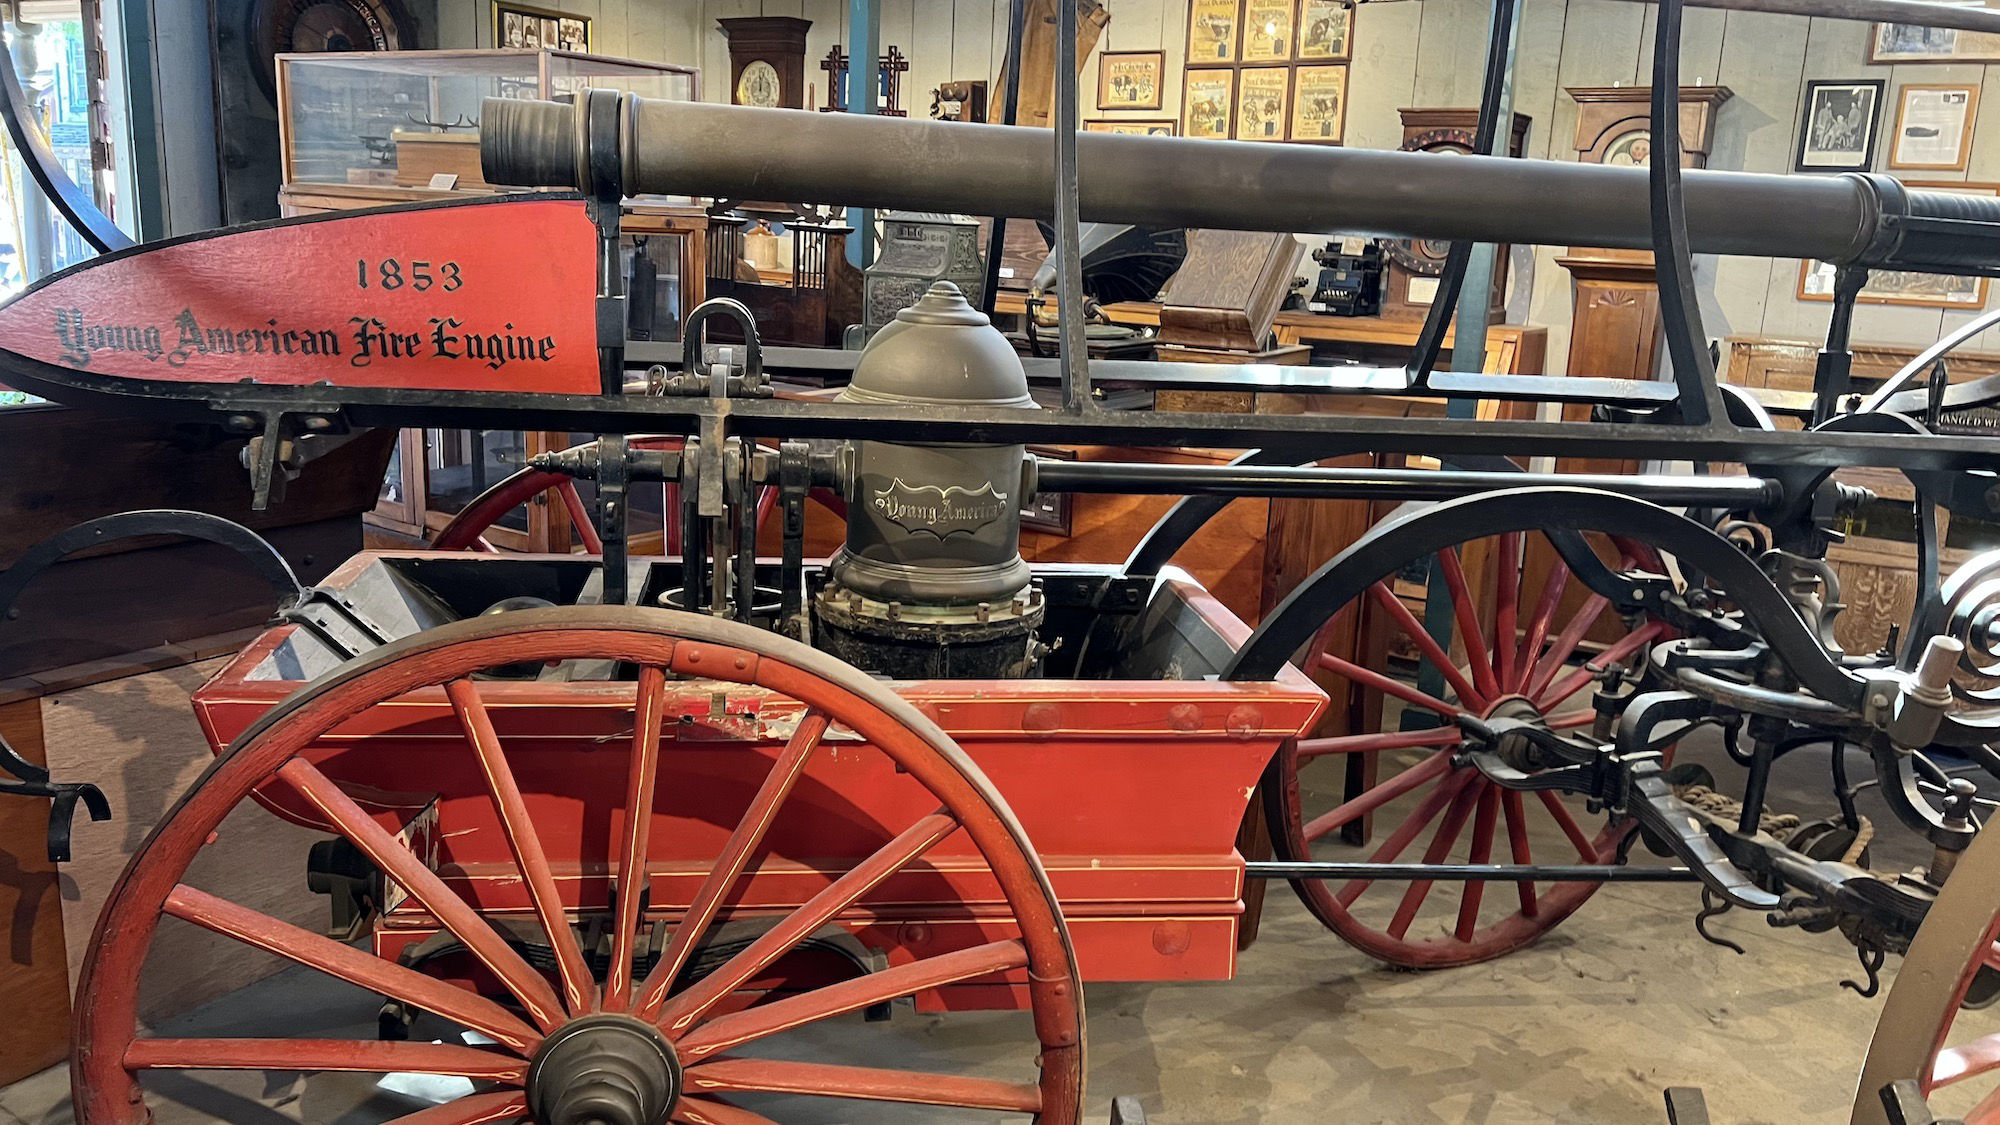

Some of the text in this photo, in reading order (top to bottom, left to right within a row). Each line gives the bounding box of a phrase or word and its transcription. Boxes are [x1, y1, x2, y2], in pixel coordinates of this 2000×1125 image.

[357, 258, 464, 292] 1853
[53, 306, 556, 371] Young American Fire Engine
[887, 495, 998, 525] Young America
